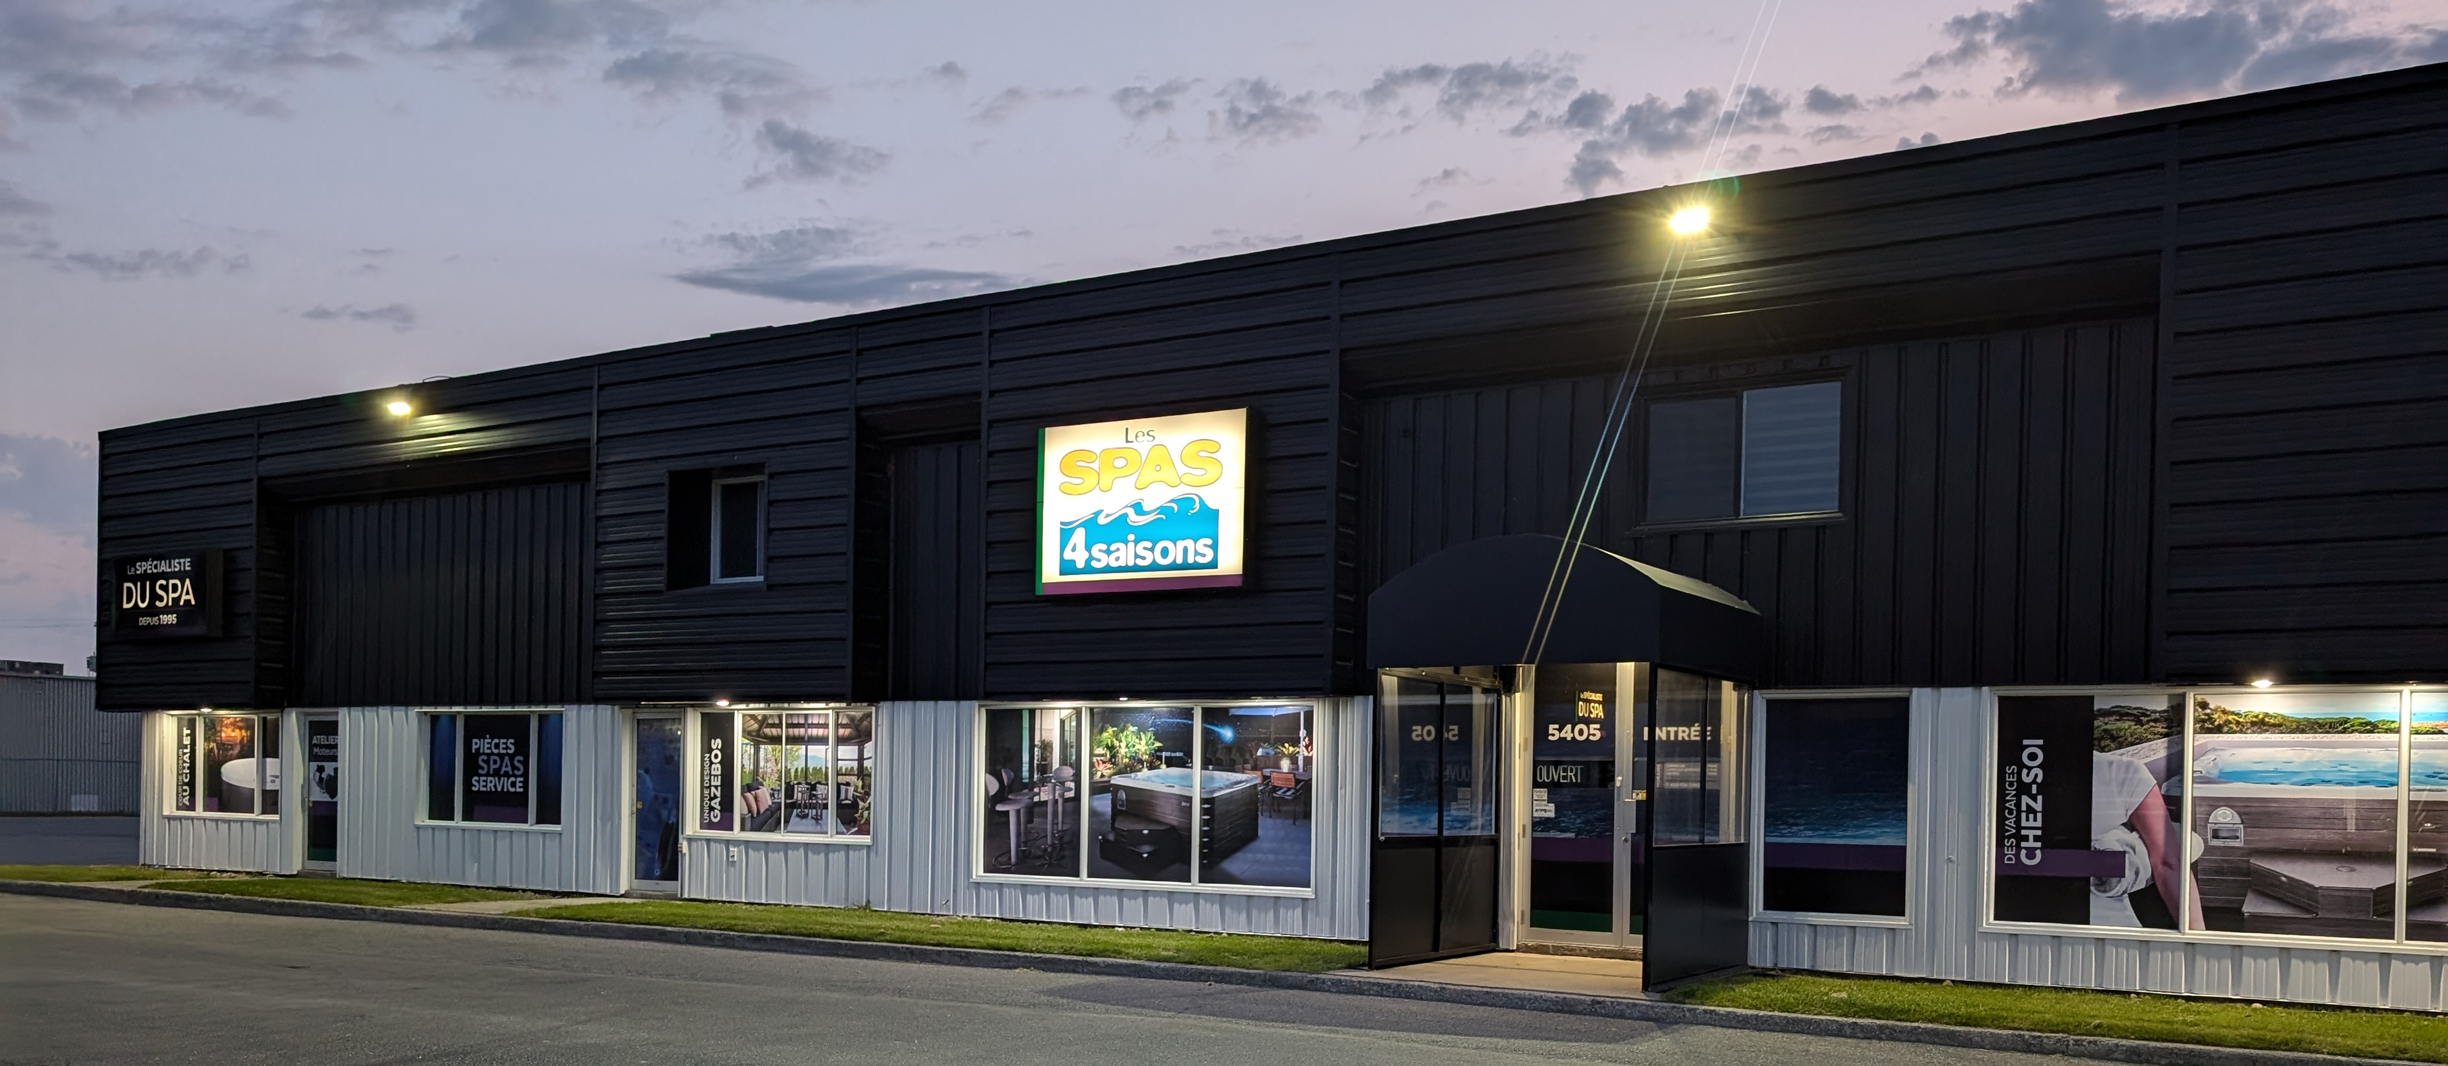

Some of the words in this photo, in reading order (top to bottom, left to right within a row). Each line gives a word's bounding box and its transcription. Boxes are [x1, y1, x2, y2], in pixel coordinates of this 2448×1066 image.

[1124, 427, 1156, 443] Les
[1058, 438, 1224, 496] SPAS
[1062, 527, 1090, 569] 4
[1090, 533, 1215, 569] saisons
[127, 565, 135, 575] Le
[135, 558, 191, 574] SPÉCIALISTE
[122, 581, 150, 609] DU
[155, 578, 196, 607] SPA
[138, 616, 159, 626] DEPUIS
[159, 614, 177, 625] 1995
[1578, 701, 1590, 717] DU
[1590, 703, 1604, 719] SPA
[1547, 723, 1602, 741] 5405
[471, 735, 515, 754] PIÈCES
[182, 727, 191, 783] CHALET
[478, 755, 524, 775] SPAS
[471, 776, 524, 792] SERVICE
[710, 738, 722, 823] GAZEBOS
[1536, 765, 1584, 783] OUVERT
[182, 786, 190, 806] AU
[2004, 765, 2018, 836] VACANCES
[2019, 739, 2044, 866] CHEZ-SOI
[2004, 838, 2016, 864] DES
